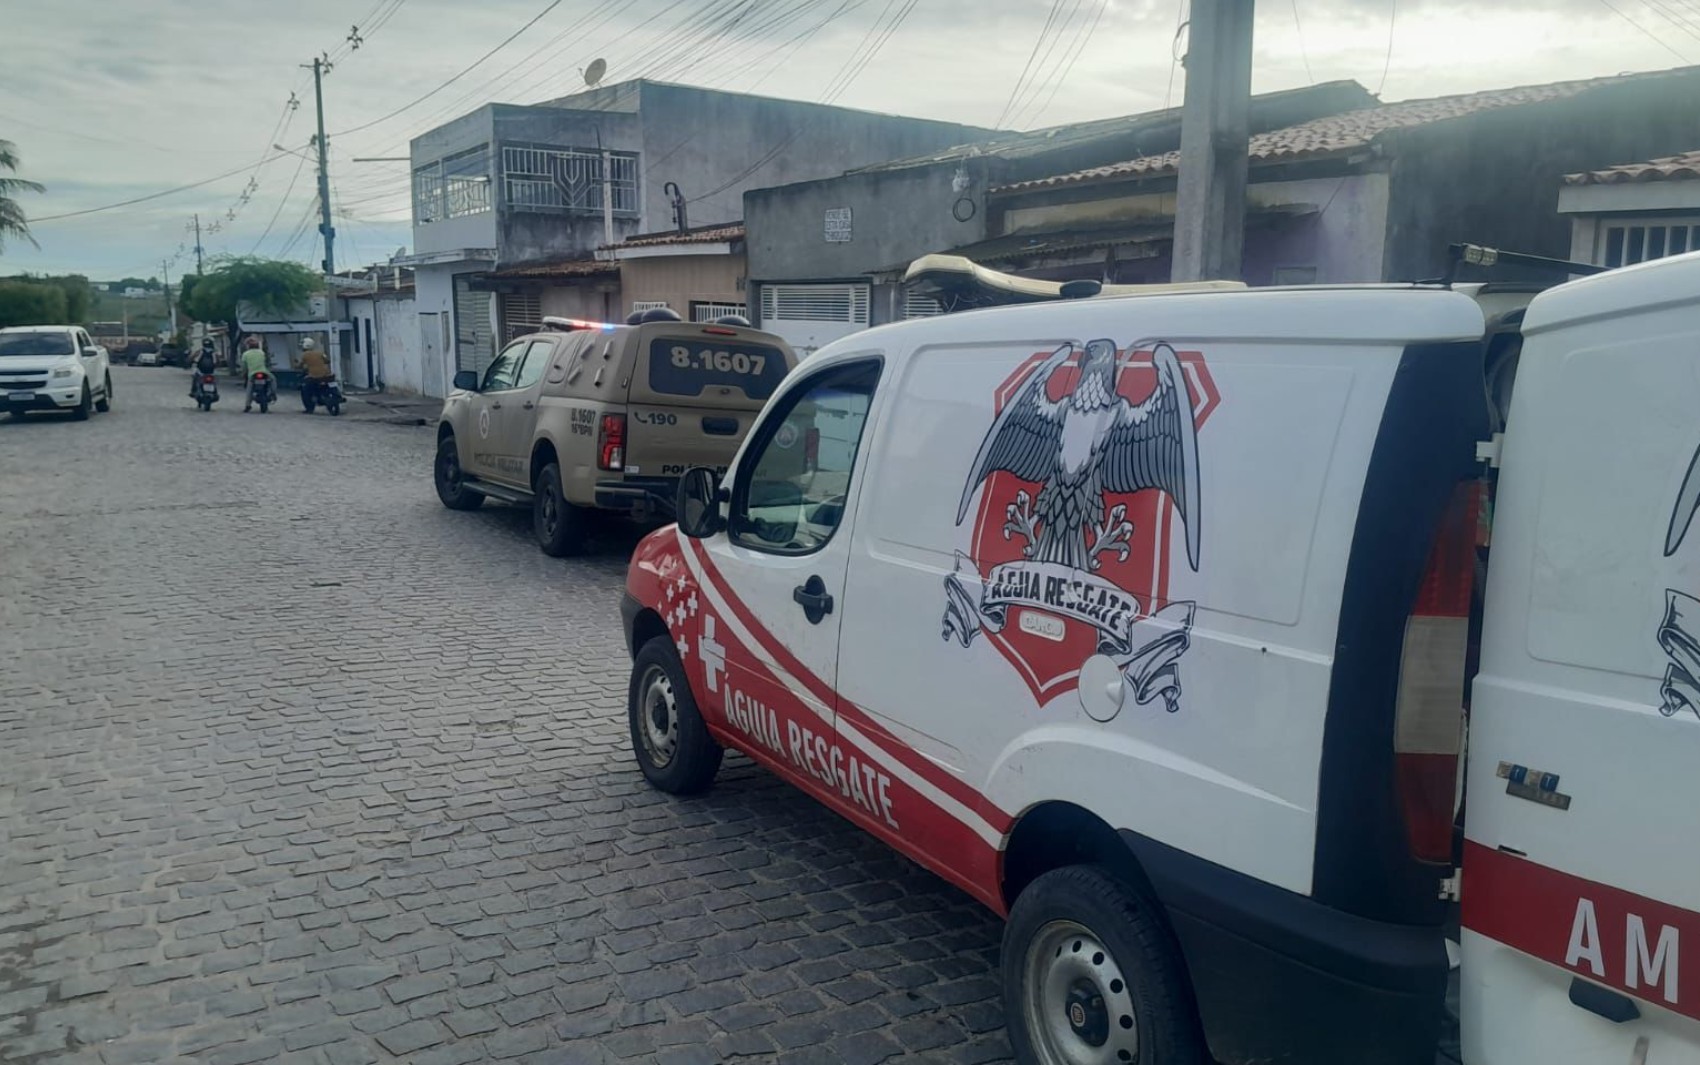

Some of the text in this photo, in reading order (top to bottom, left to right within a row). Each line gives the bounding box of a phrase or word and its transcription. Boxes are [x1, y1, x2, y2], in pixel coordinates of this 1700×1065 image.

[671, 346, 765, 375] 8.1607
[648, 413, 677, 426] 190
[1044, 575, 1132, 631] RESGATE
[724, 672, 899, 830] ÁGUIA RESGATE
